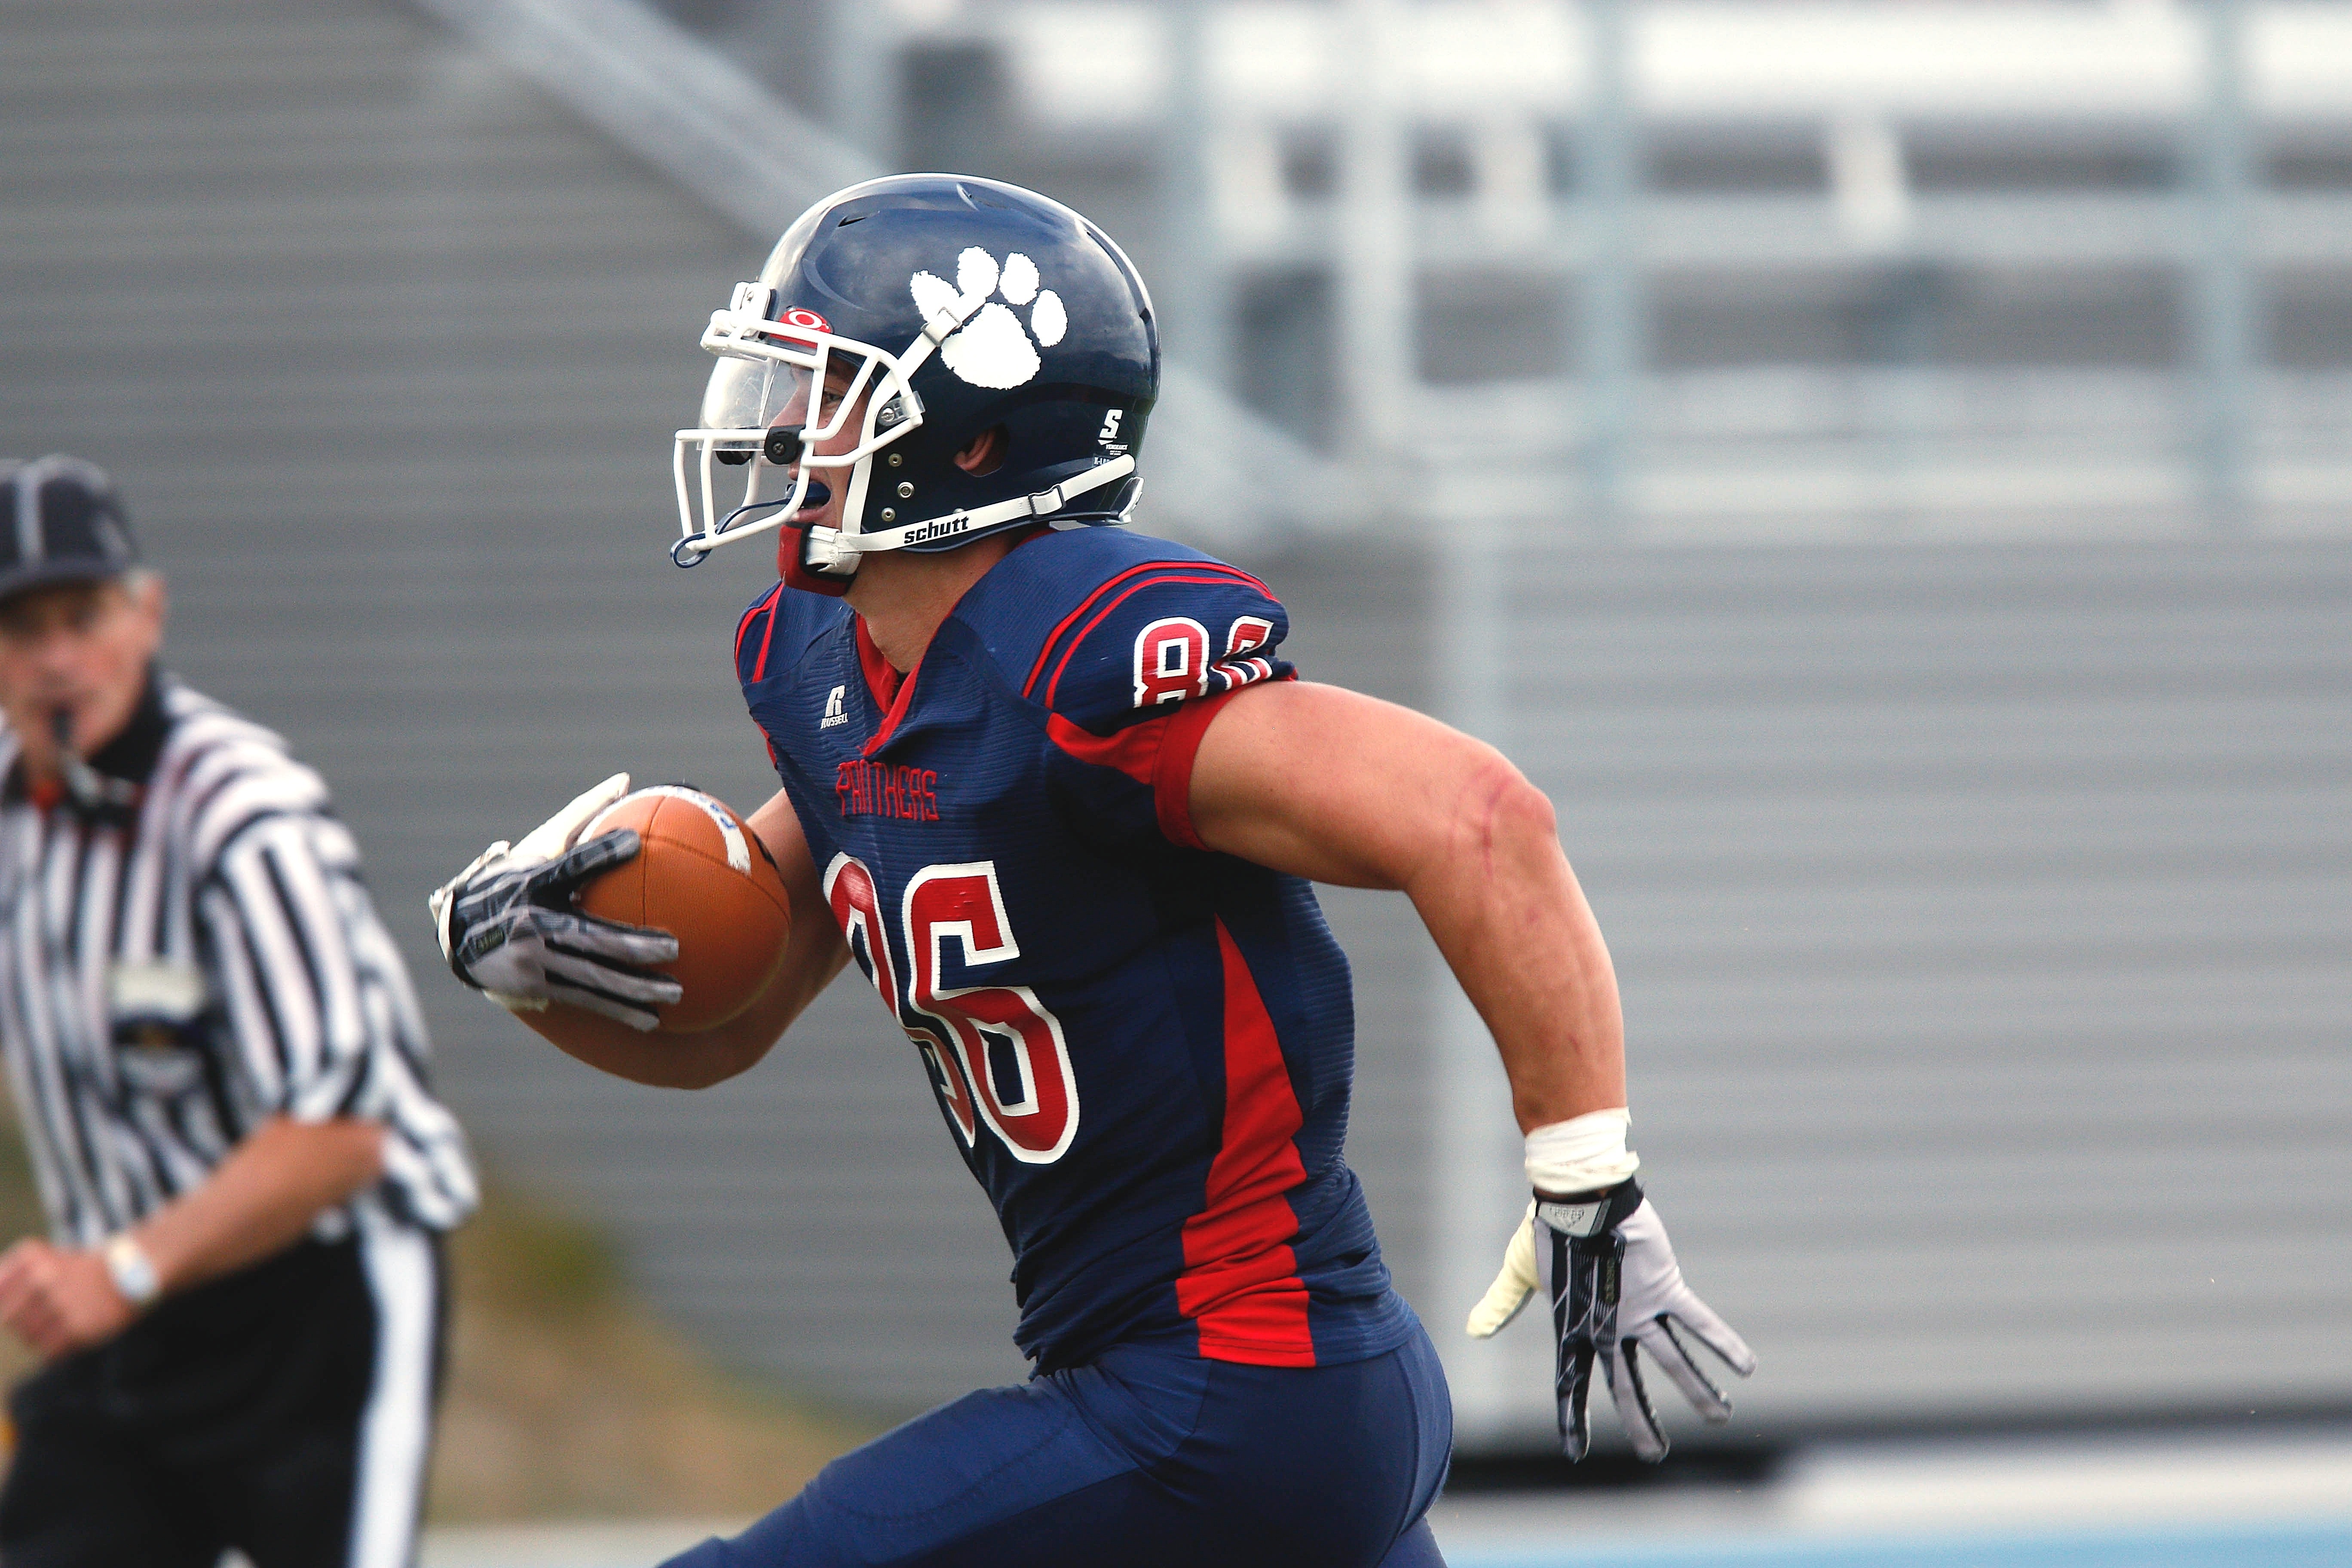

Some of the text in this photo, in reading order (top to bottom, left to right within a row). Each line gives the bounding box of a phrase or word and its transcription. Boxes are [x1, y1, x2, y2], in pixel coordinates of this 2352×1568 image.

[1099, 409, 1123, 438] S
[904, 516, 969, 544] schutt
[821, 712, 848, 729] RUSSELL
[836, 759, 940, 821] PANTHERS
